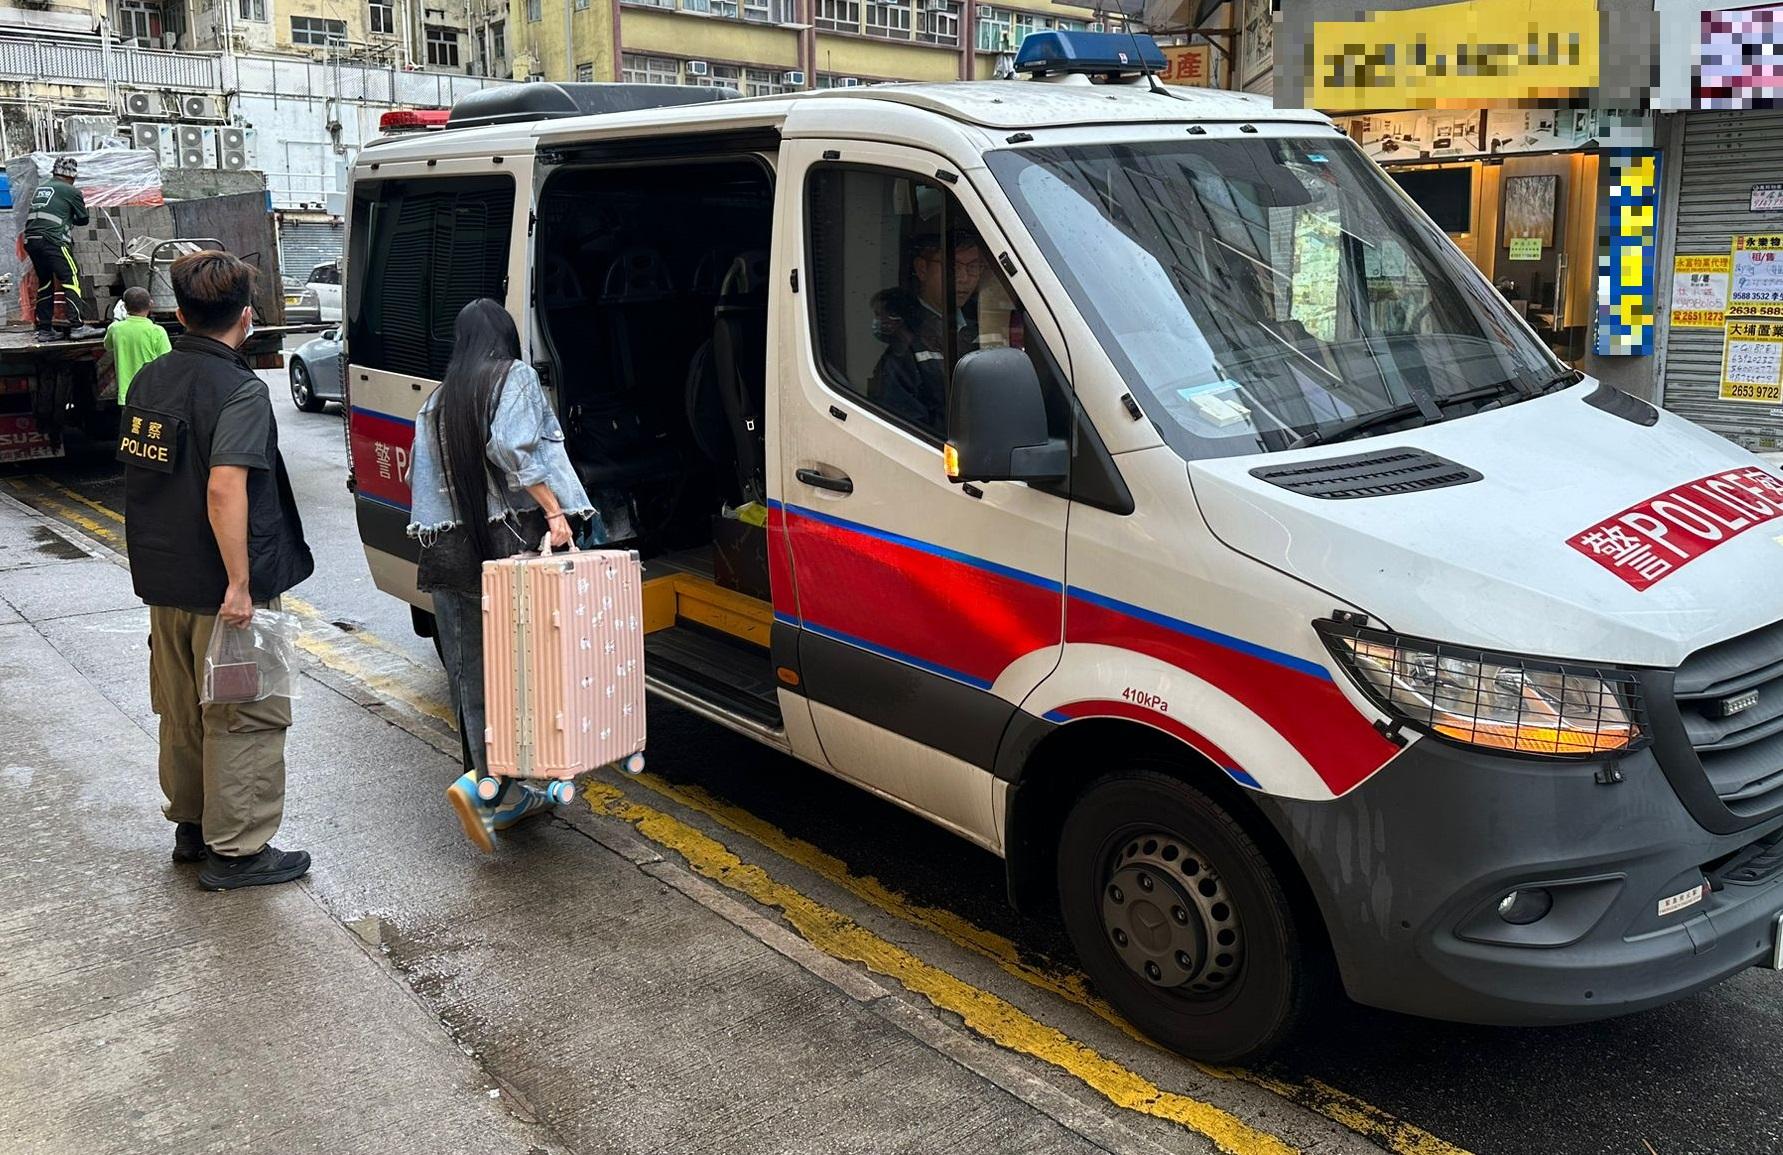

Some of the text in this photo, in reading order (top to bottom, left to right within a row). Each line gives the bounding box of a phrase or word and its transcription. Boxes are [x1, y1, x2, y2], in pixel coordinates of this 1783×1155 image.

[1746, 237, 1783, 247] 永樂物
[1733, 292, 1751, 300] 9588
[1752, 292, 1770, 300] 3532
[1683, 311, 1724, 321] 2651 1273
[1730, 306, 1757, 314] 2638
[1730, 324, 1783, 337] 大埔置業
[1732, 385, 1779, 399] 2653 9722
[131, 416, 162, 440] 警察
[120, 437, 168, 462] POLICE
[1618, 473, 1783, 560] POLICE
[1580, 525, 1673, 581] 警
[1122, 687, 1168, 712] 410kPa
